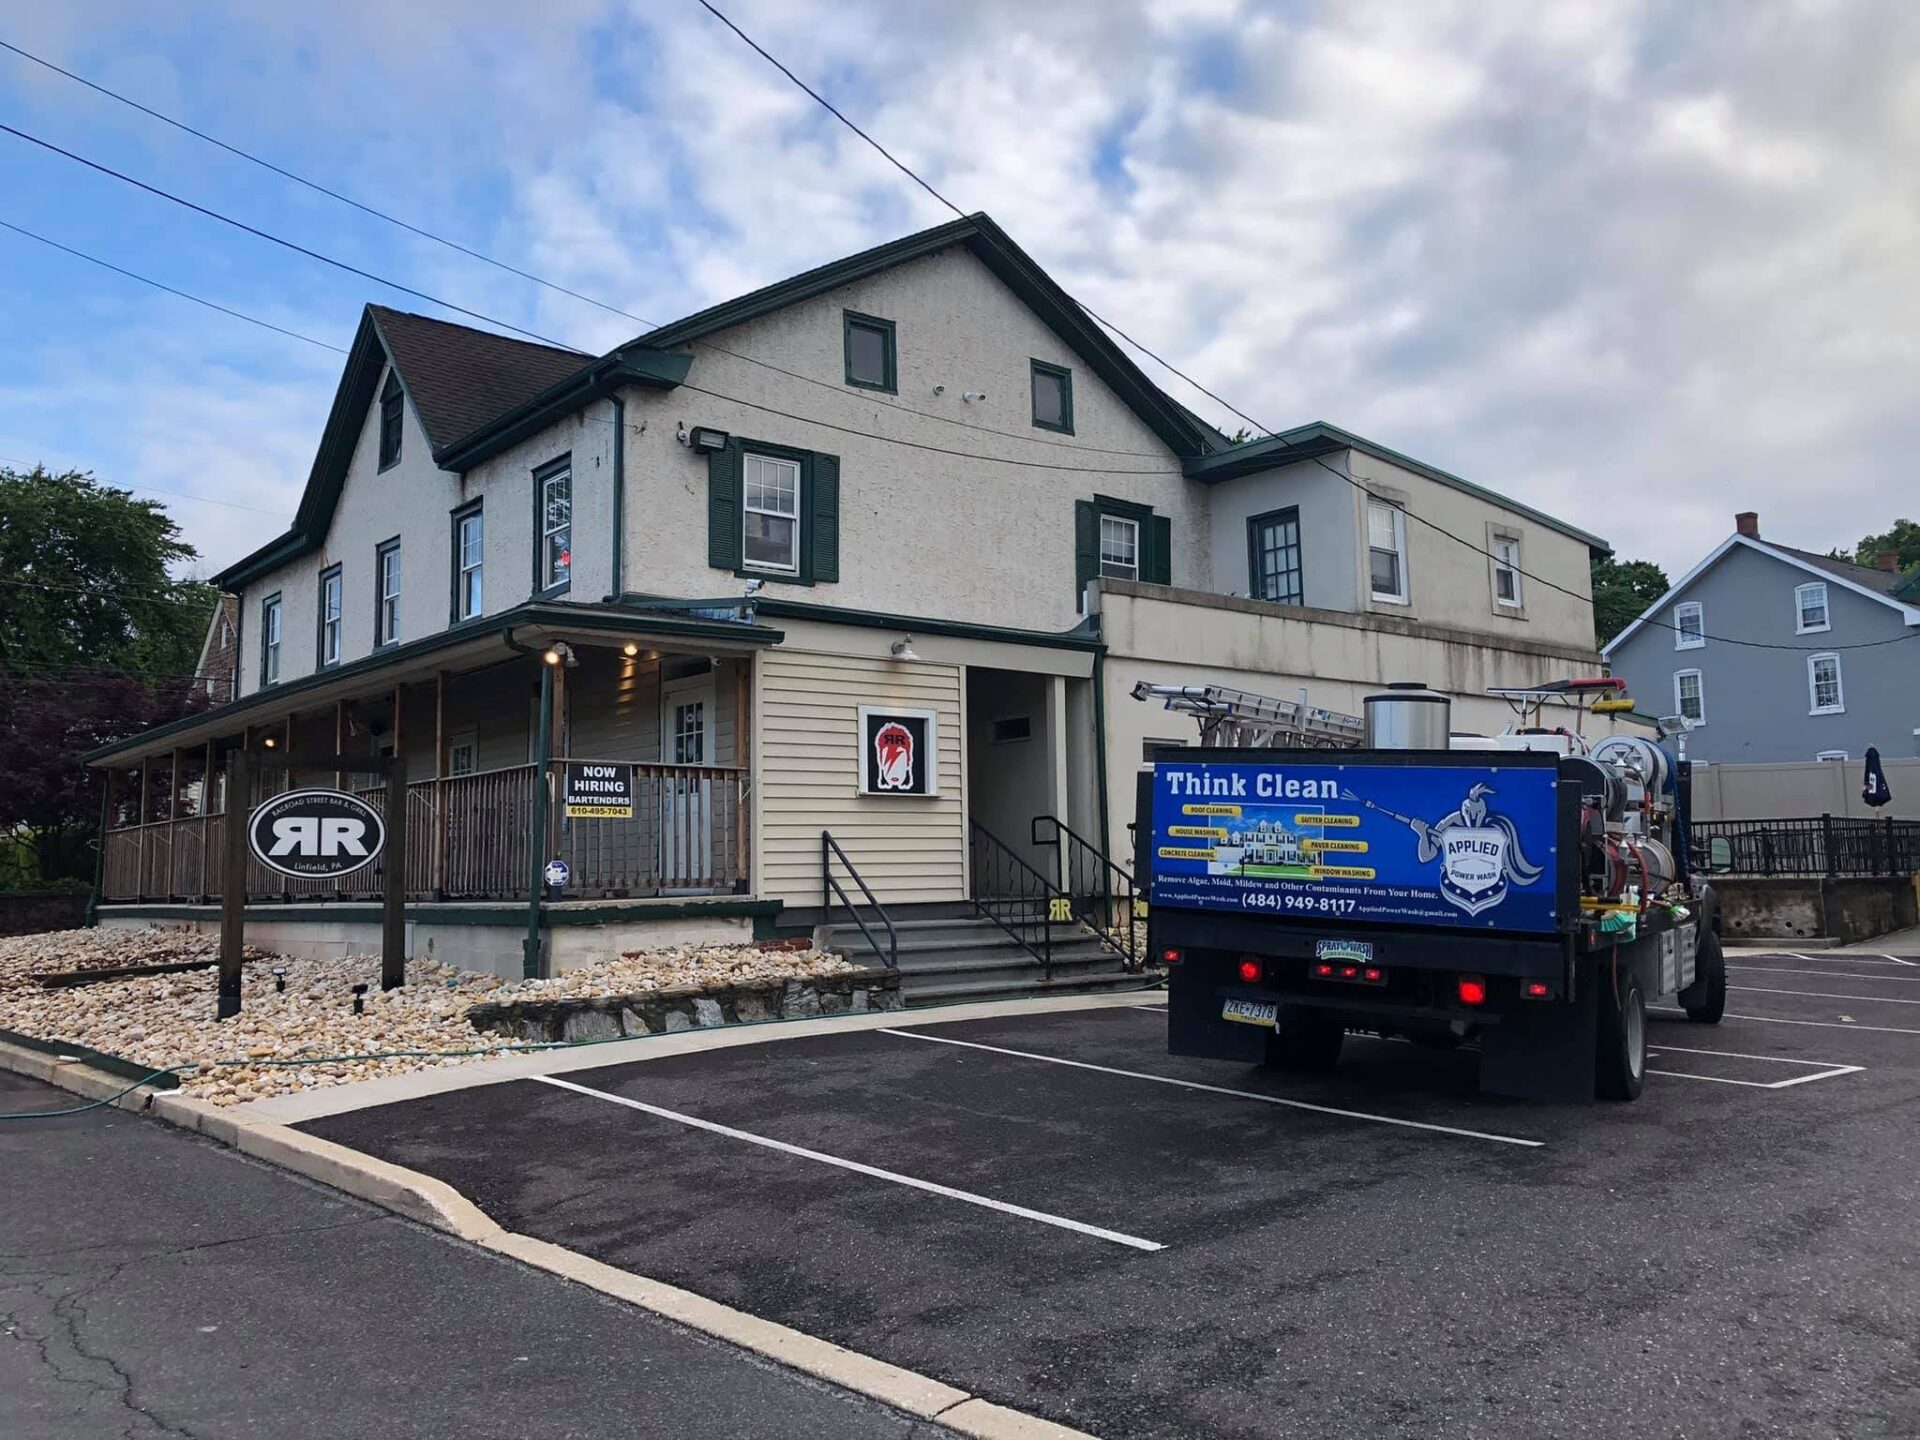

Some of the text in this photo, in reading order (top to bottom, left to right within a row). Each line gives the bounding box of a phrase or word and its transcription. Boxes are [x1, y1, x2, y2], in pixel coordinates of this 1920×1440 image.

[583, 766, 617, 778] NOW
[574, 780, 625, 792] HIRING
[1166, 772, 1338, 798] Think Clean
[568, 796, 630, 804] BARTENDERS
[271, 799, 304, 817] RAILROAD
[350, 804, 367, 817] GRILL
[571, 807, 628, 816] 610-495-7043
[1323, 817, 1353, 825] CLEANING
[1310, 842, 1360, 850] PAVER CLEANING
[1448, 840, 1499, 856] APPLIED
[1160, 848, 1215, 858] CONCRETE CLEANING
[294, 862, 328, 872] Linfield,
[1314, 868, 1371, 878] WINDOW WASHING
[1450, 870, 1498, 880] POWER WASH
[1158, 874, 1438, 900] Remove Algae, Mold, Mildew and Other Contaminants From Your Home.
[1242, 892, 1356, 912] (484) 949-8117
[1358, 905, 1458, 918] AppliedPowerWash@gmail.com
[1350, 942, 1373, 960] WASH
